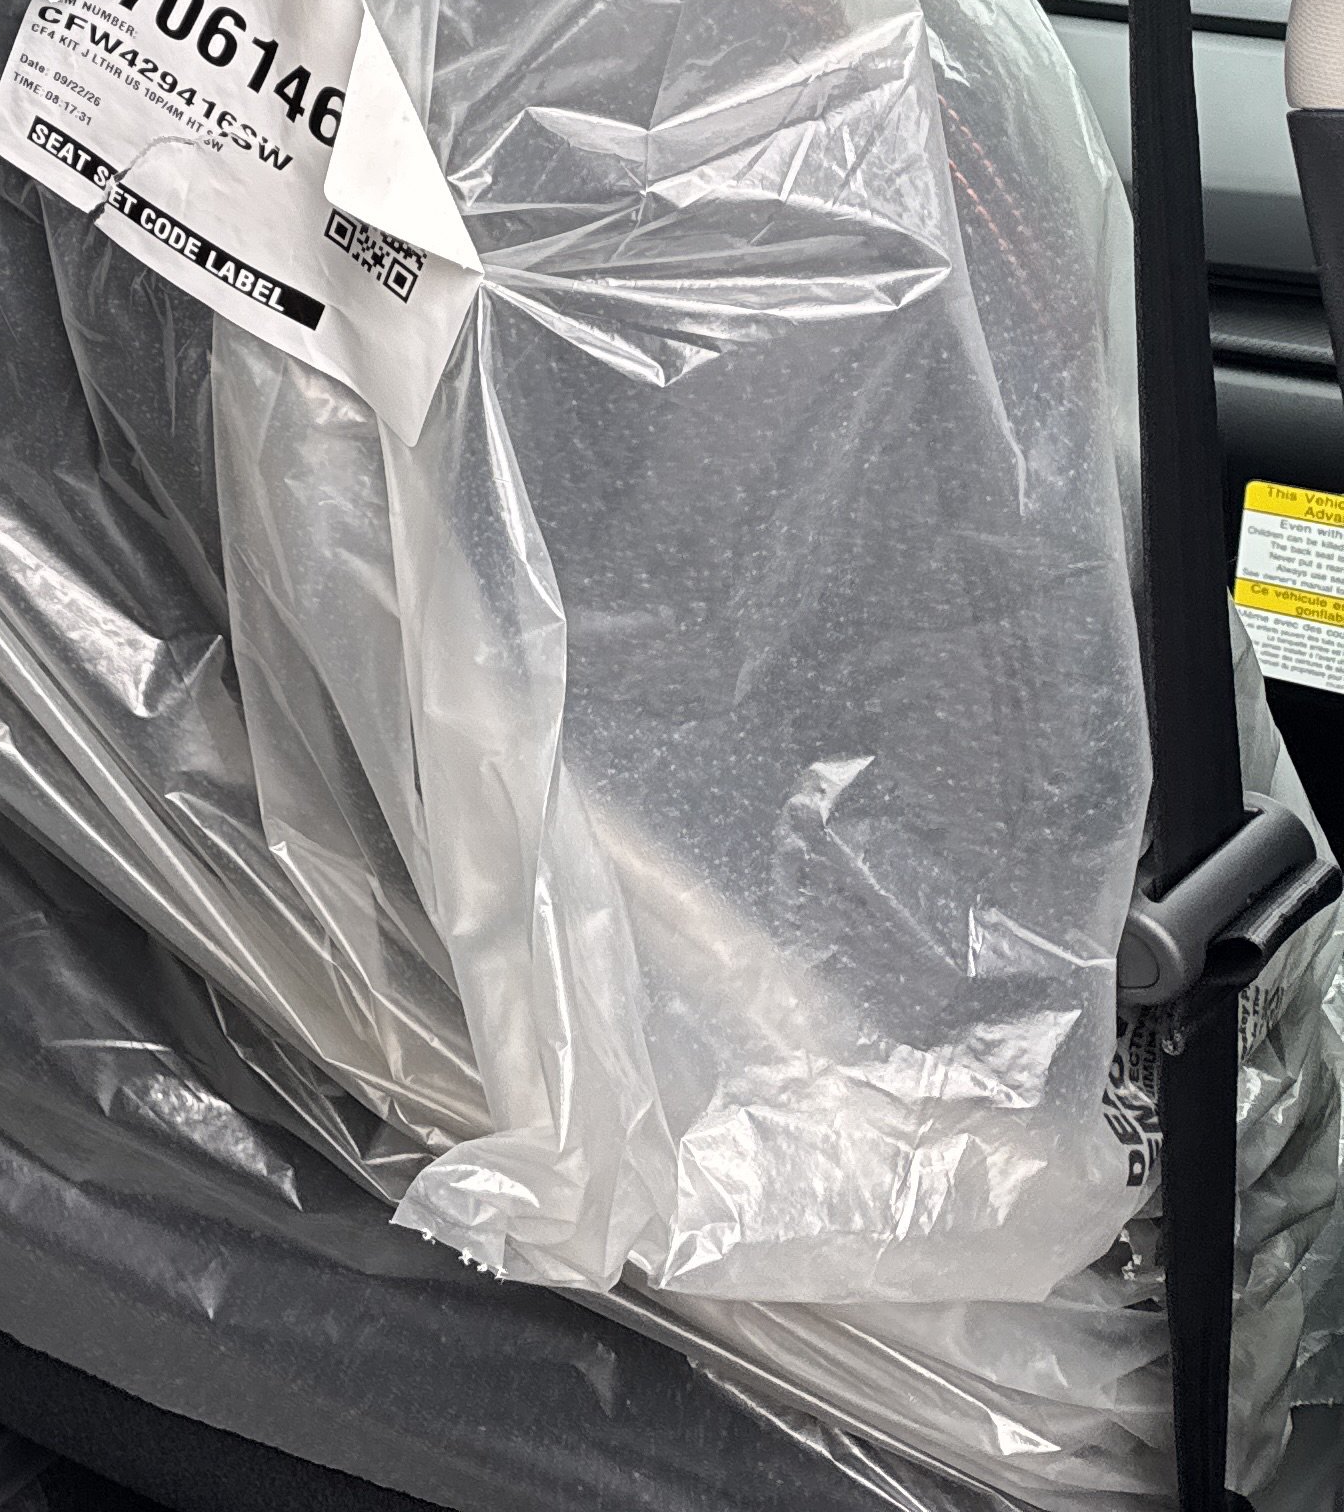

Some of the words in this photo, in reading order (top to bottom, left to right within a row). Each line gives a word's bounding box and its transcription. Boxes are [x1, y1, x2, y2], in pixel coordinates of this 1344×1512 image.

[81, 0, 139, 39] NUMBER:
[19, 53, 50, 76] Date:
[31, 23, 56, 40] CF4
[58, 35, 80, 51] KIT
[81, 48, 90, 58] J
[92, 53, 123, 79] LTHR
[124, 74, 142, 91] US
[144, 87, 184, 121] 10P/4M
[186, 116, 205, 133] HT
[30, 123, 92, 173] SEAT
[93, 161, 139, 219] SET
[139, 208, 202, 262] CODE
[203, 248, 288, 314] LABEL
[1267, 485, 1297, 501] This
[1280, 519, 1312, 534] Even
[1317, 528, 1343, 540] with
[1250, 583, 1269, 596] Ce
[1274, 589, 1328, 608] véhicule
